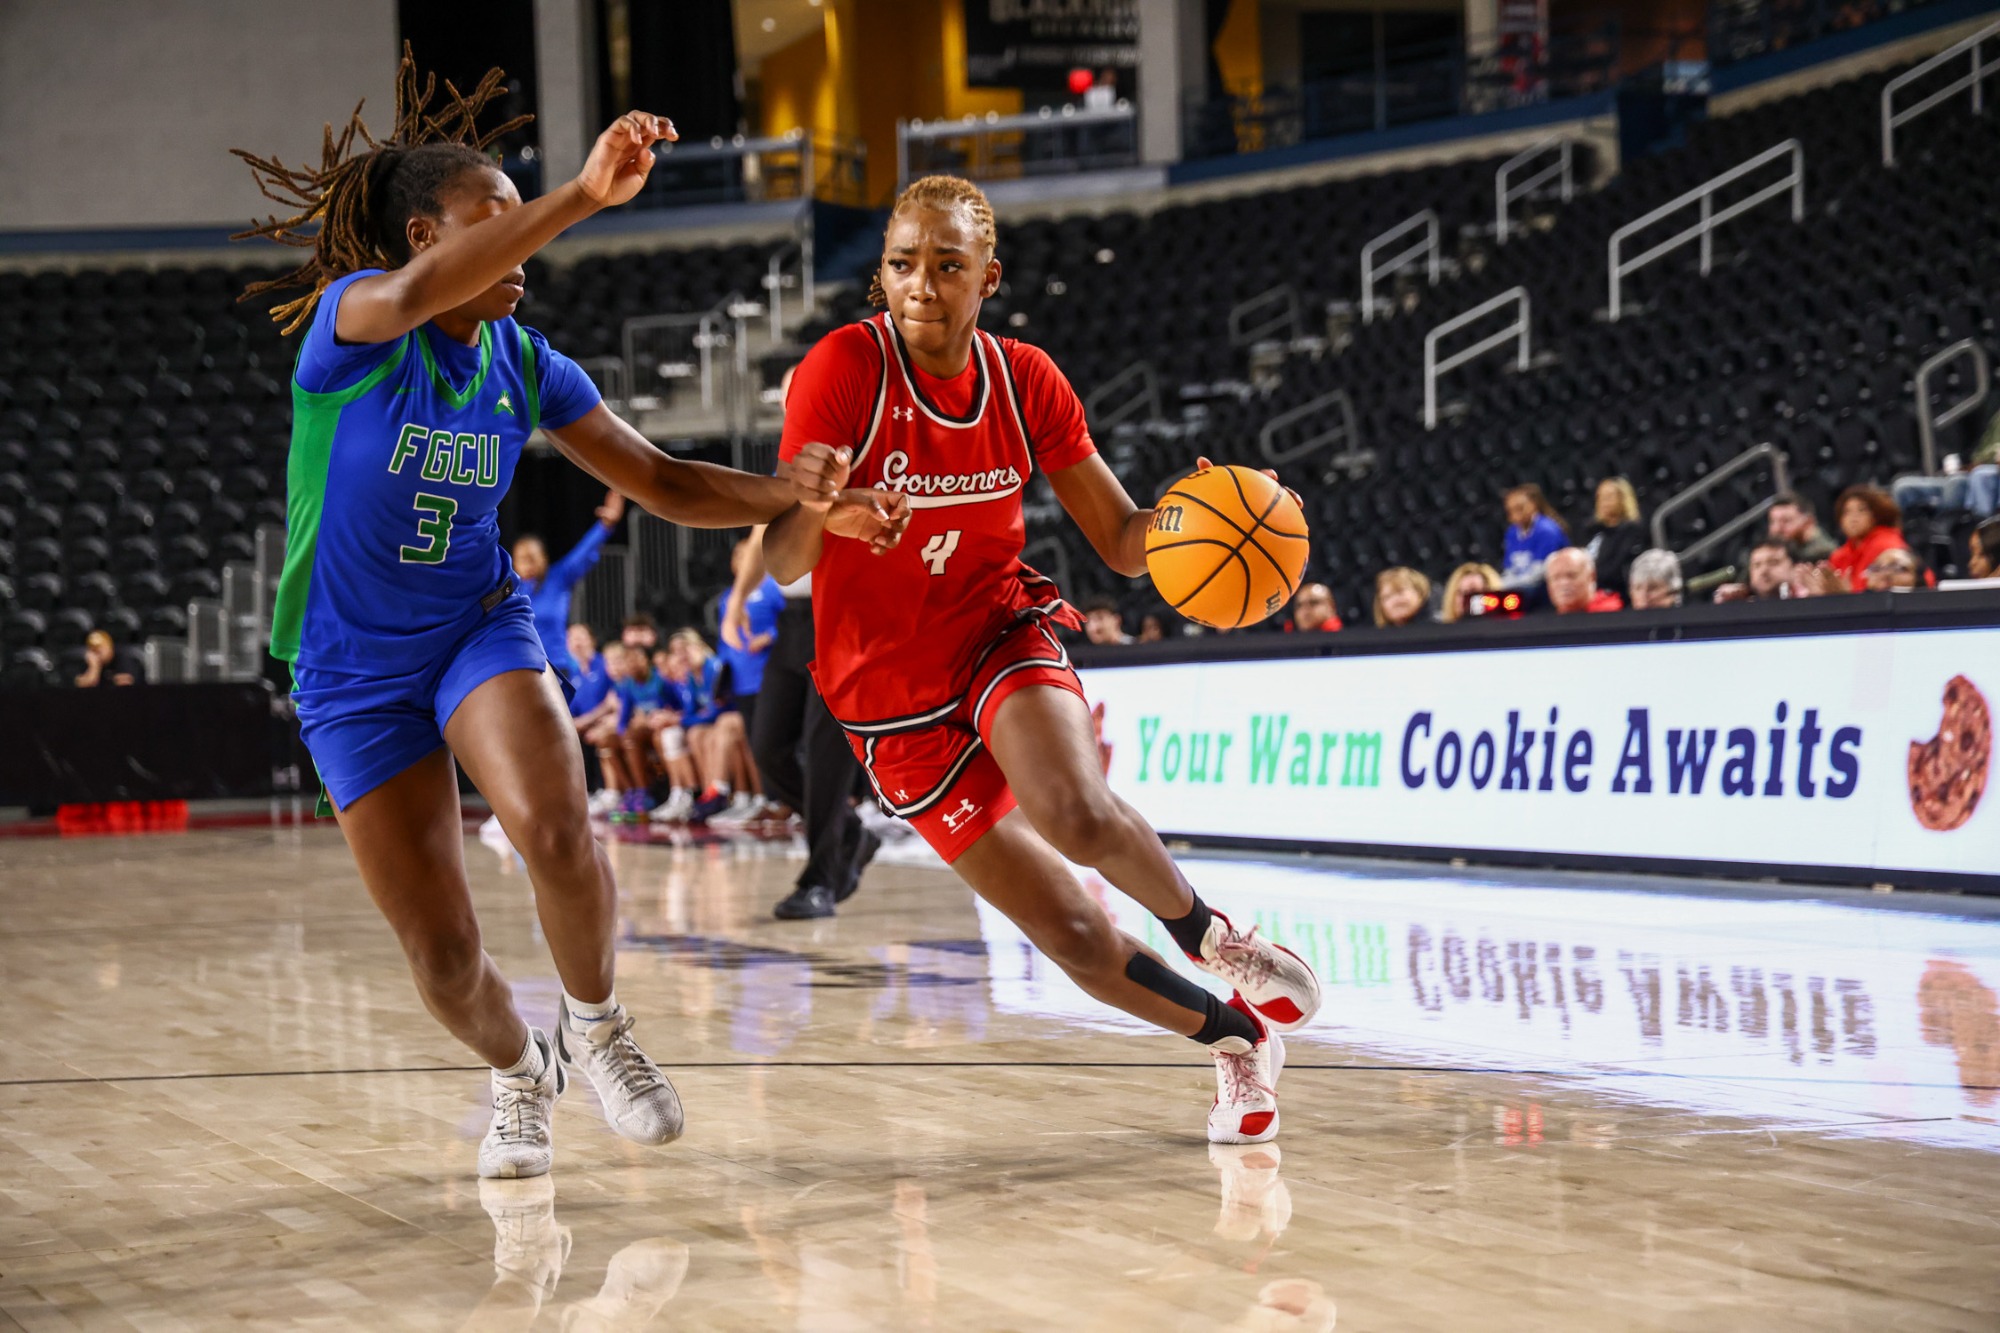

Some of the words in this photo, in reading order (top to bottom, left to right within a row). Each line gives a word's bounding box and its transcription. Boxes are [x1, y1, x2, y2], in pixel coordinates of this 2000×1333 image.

[388, 423, 500, 487] FGCU
[873, 449, 1022, 497] Governors
[400, 492, 458, 565] 3
[920, 530, 962, 576] 4
[1137, 716, 1233, 783] Your
[1249, 714, 1383, 787] Warm
[1400, 705, 1593, 793] Cookie
[1611, 700, 1863, 799] Awaits
